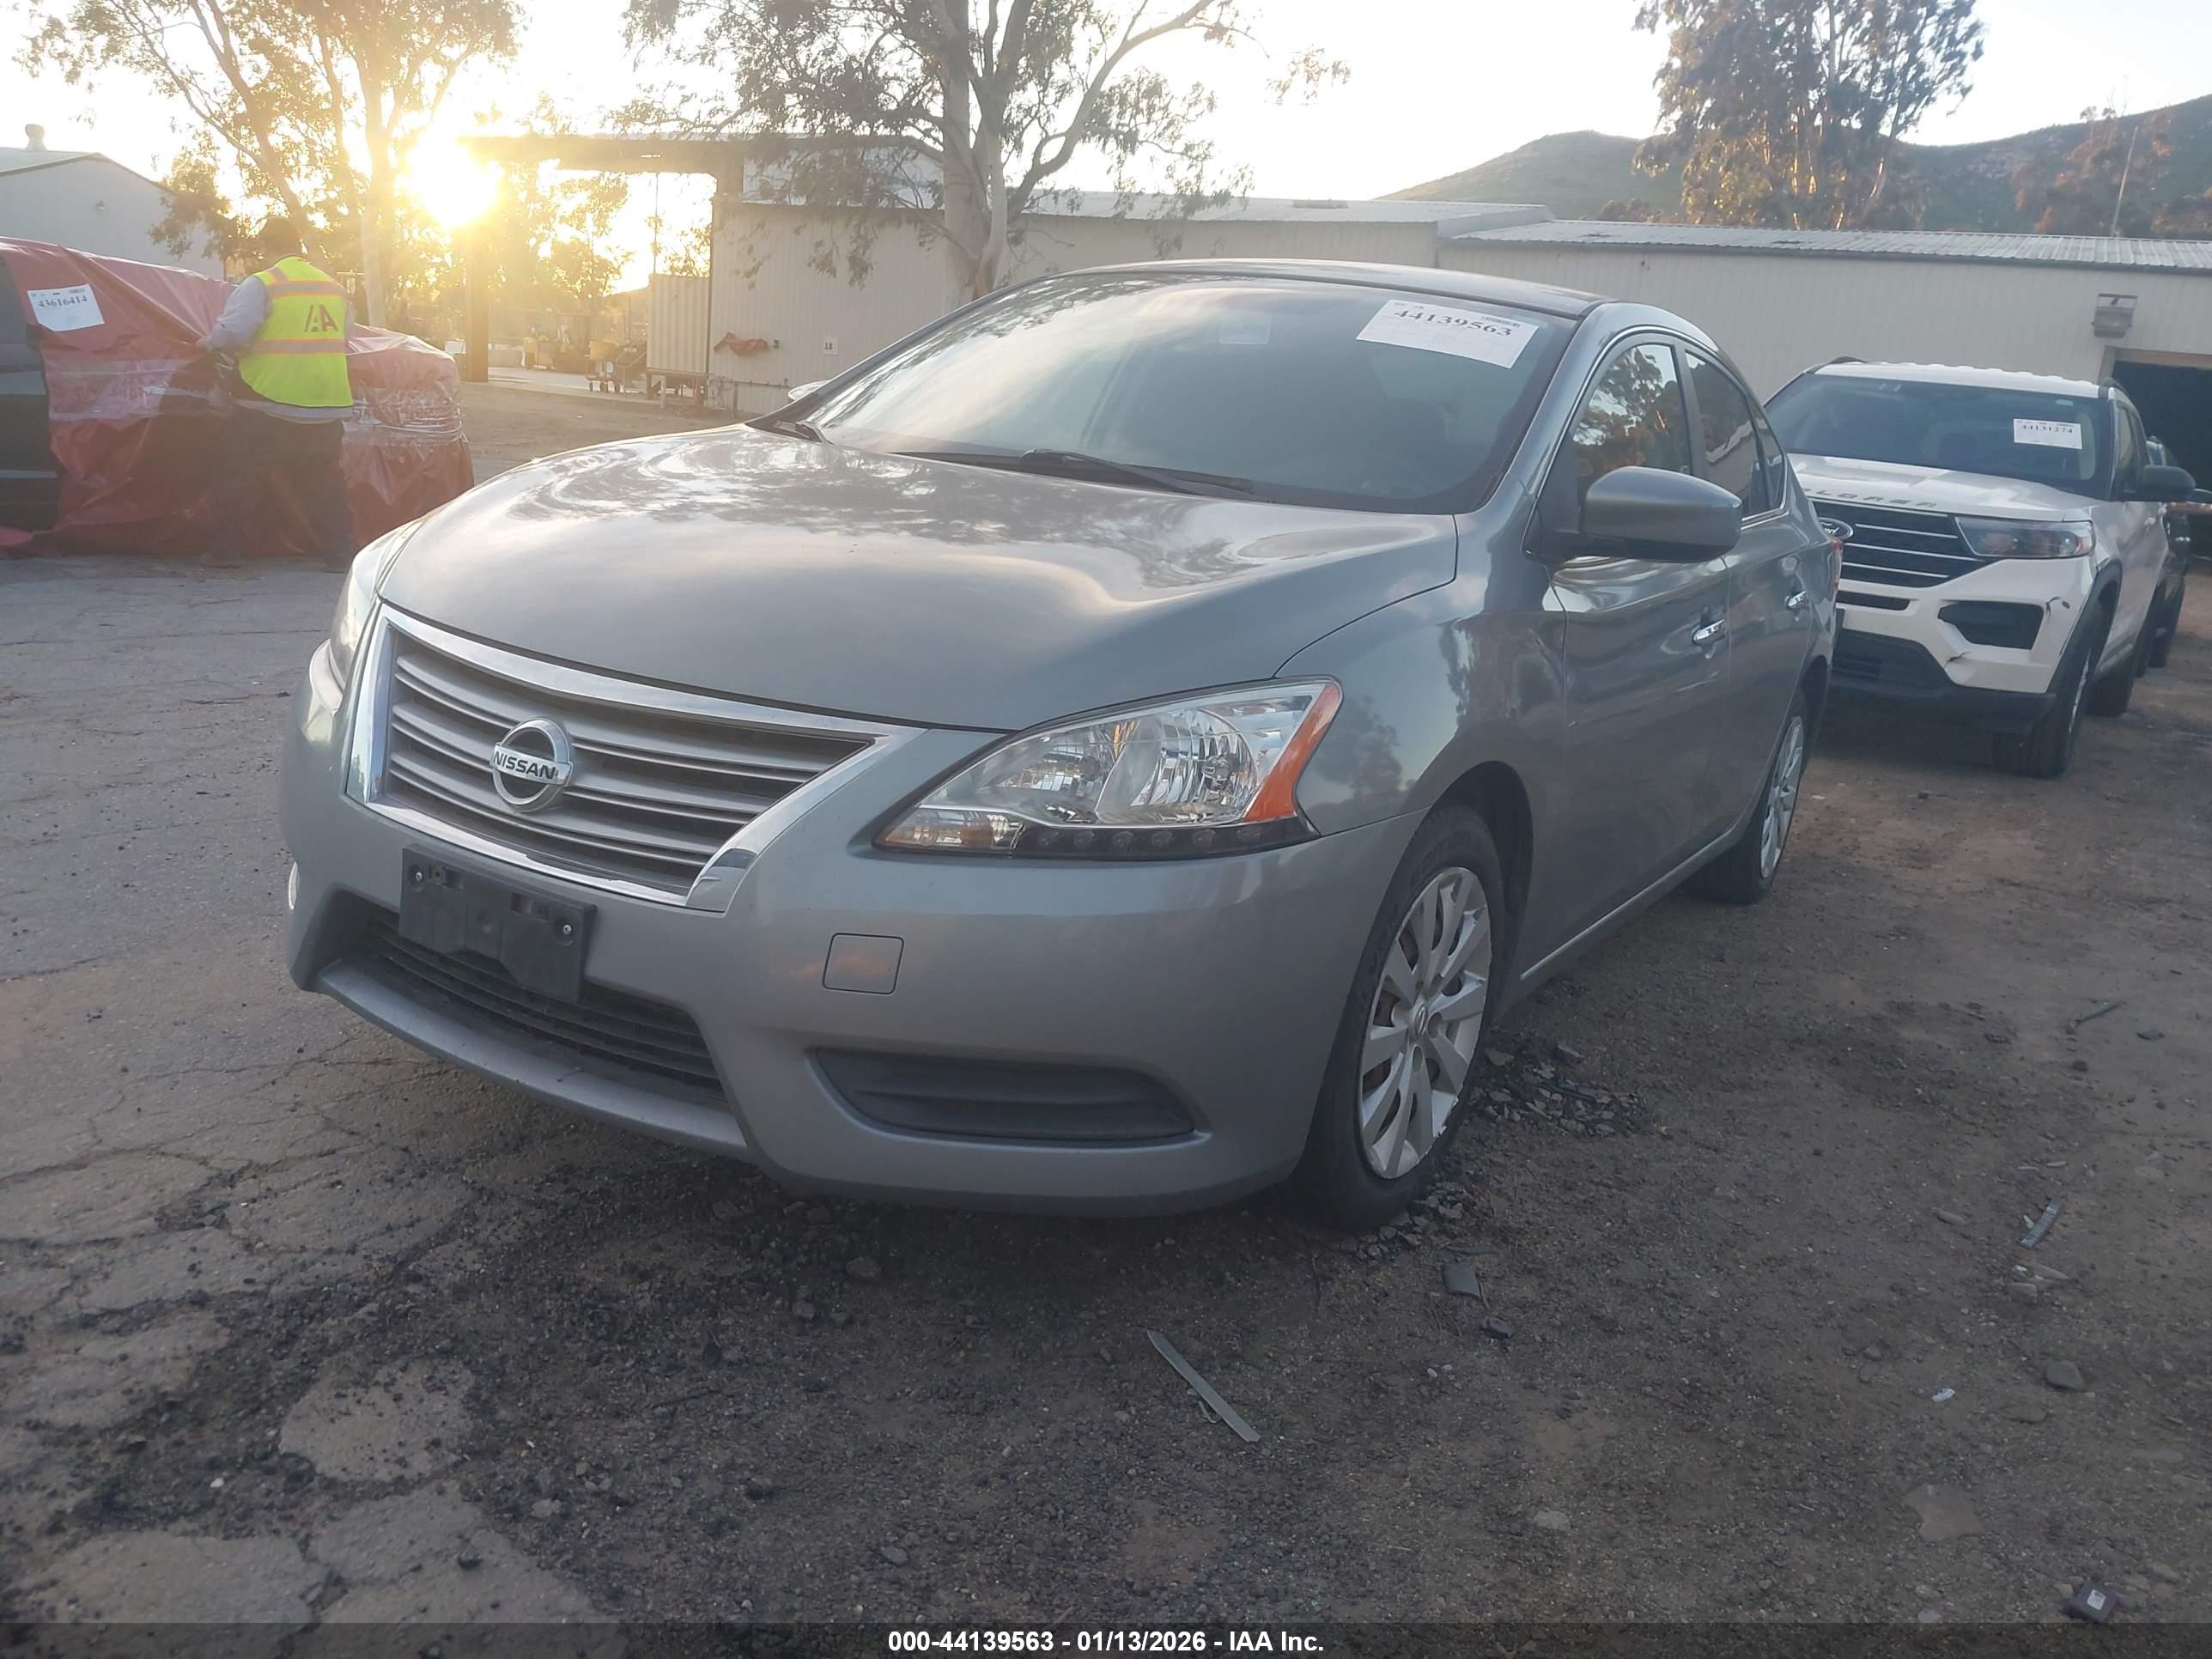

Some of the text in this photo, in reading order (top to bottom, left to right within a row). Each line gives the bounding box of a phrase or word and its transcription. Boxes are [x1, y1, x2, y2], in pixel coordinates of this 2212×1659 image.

[39, 295, 88, 307] 43616414
[1394, 309, 1512, 337] 44139563
[493, 750, 556, 779] NISSAN
